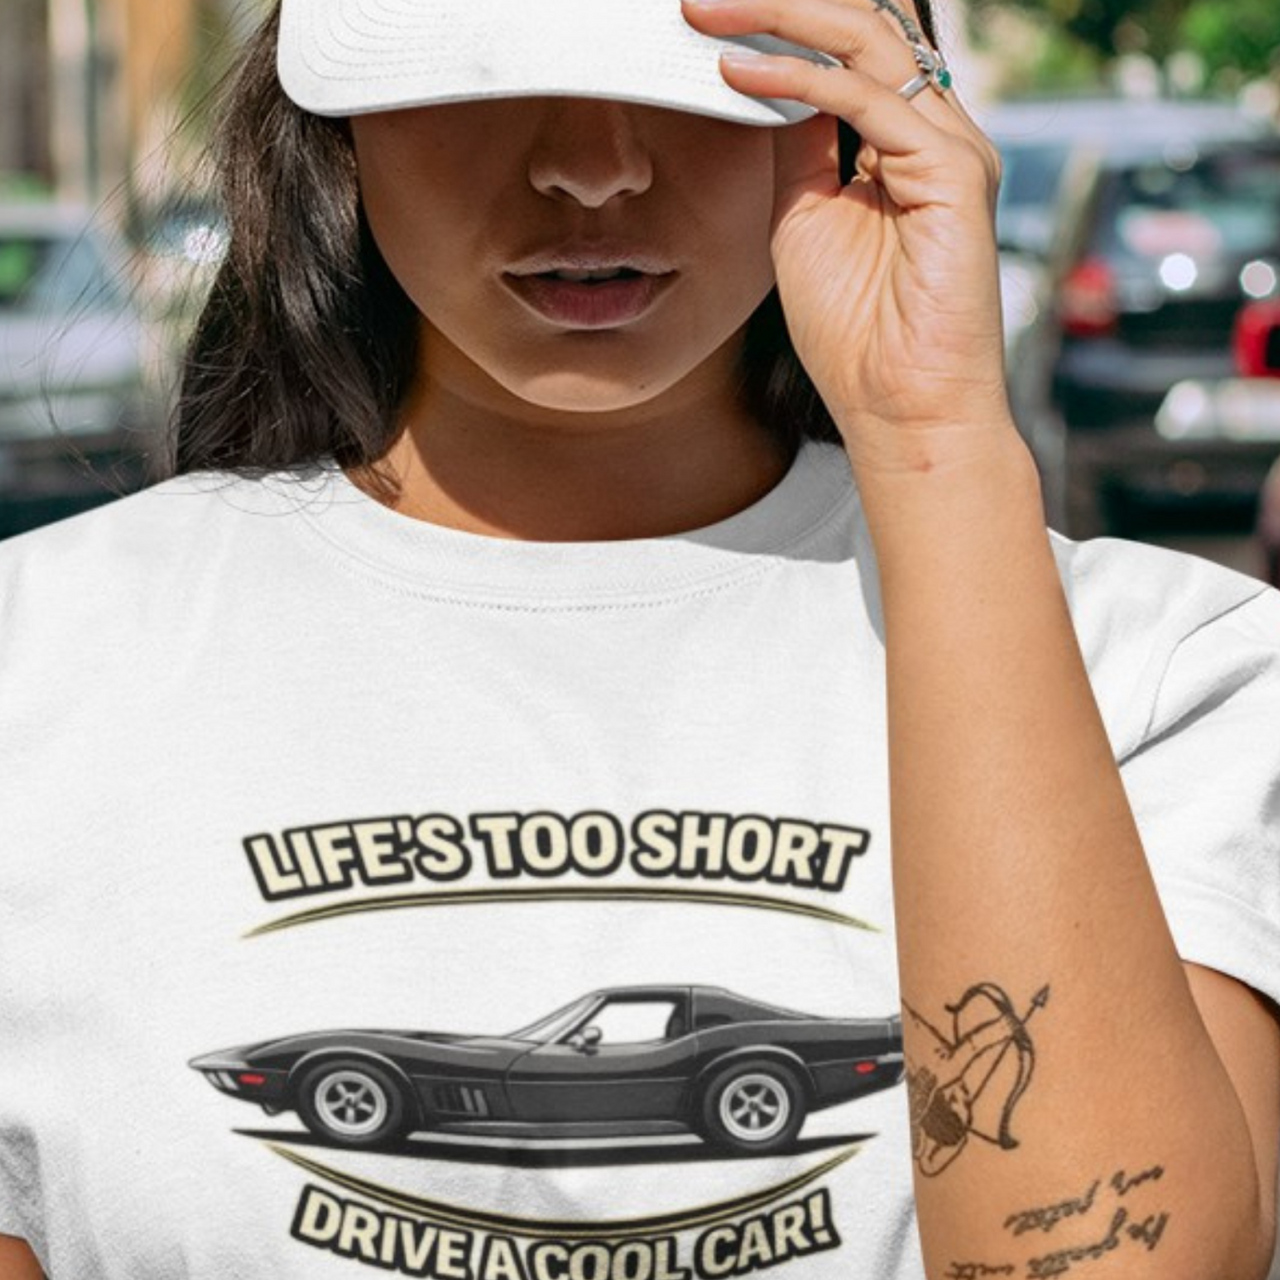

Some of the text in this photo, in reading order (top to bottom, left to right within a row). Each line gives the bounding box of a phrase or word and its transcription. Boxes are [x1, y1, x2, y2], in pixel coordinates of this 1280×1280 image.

[245, 811, 868, 899] LIFE'S TOO SHORT
[696, 1189, 838, 1280] CAR!
